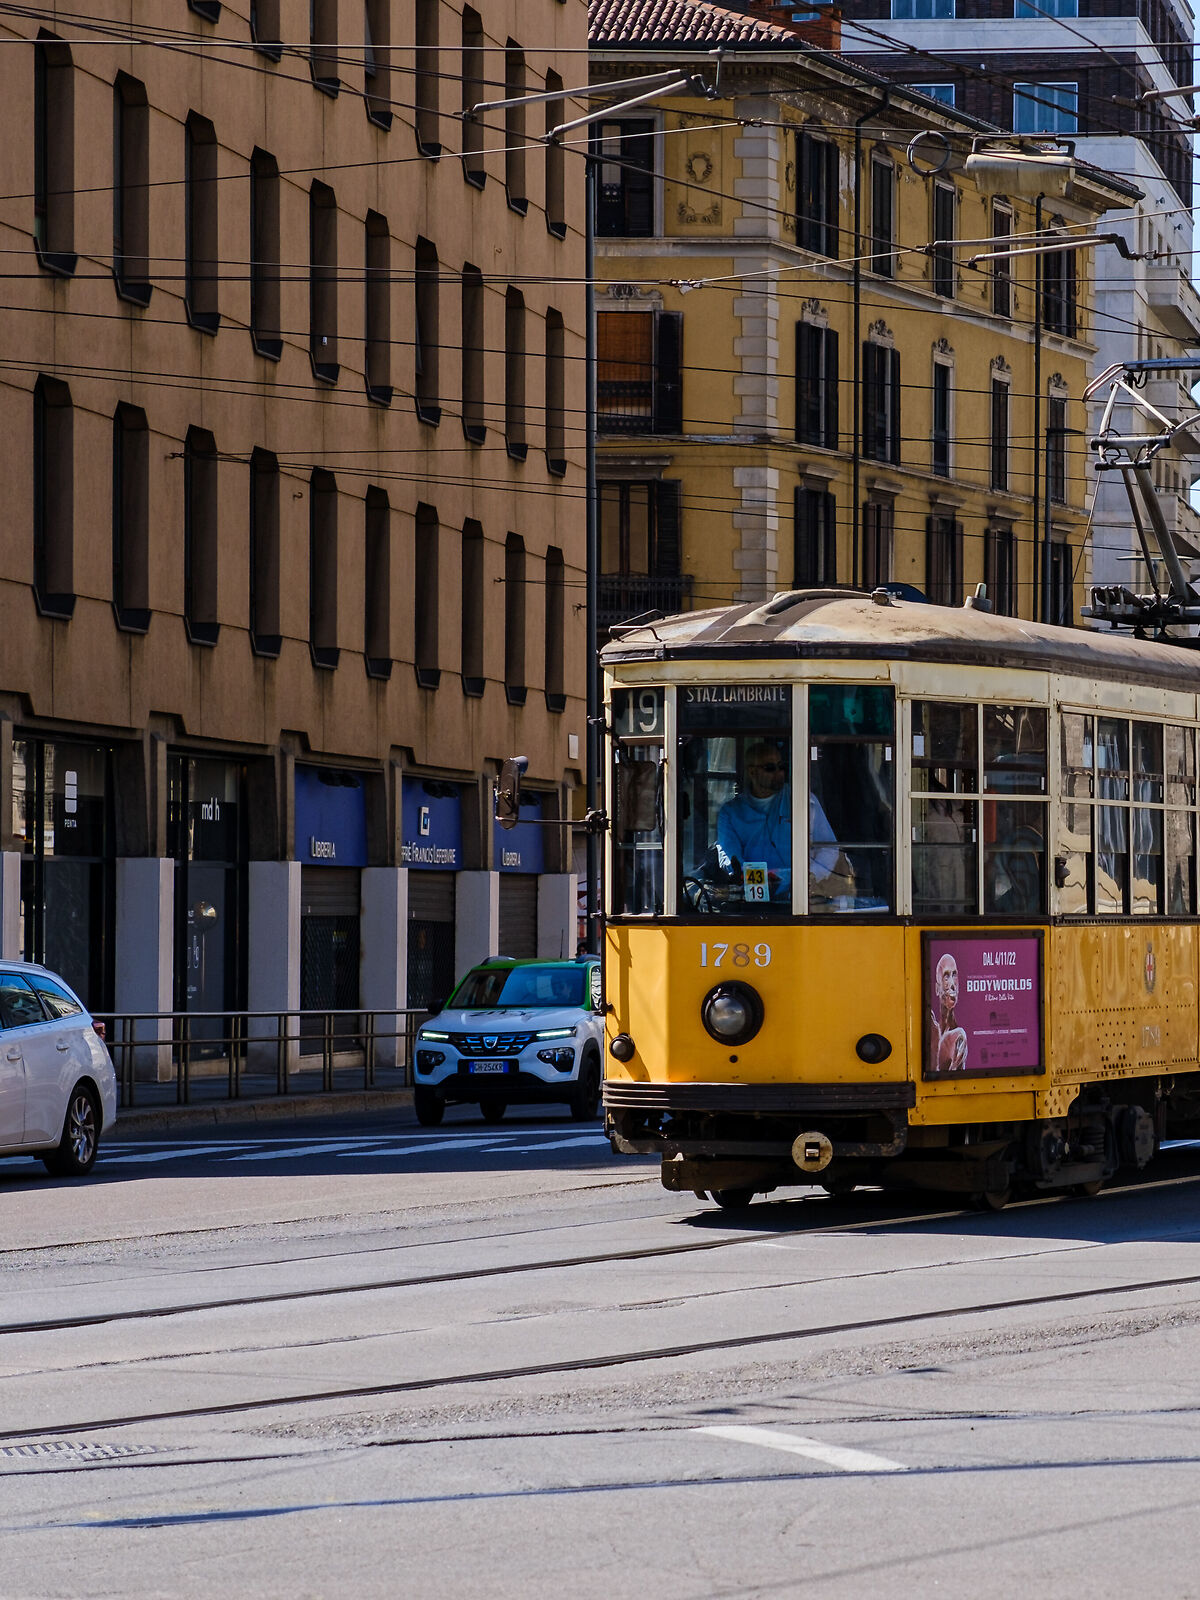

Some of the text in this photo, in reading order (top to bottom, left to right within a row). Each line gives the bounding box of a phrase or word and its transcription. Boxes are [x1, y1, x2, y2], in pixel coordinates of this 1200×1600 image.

[627, 689, 658, 733] 19
[748, 870, 763, 884] 43
[750, 886, 764, 899] 19
[700, 942, 772, 968] 1789
[982, 951, 1016, 966] DAL 4/11/22
[966, 978, 1033, 992] BODYWORLDS
